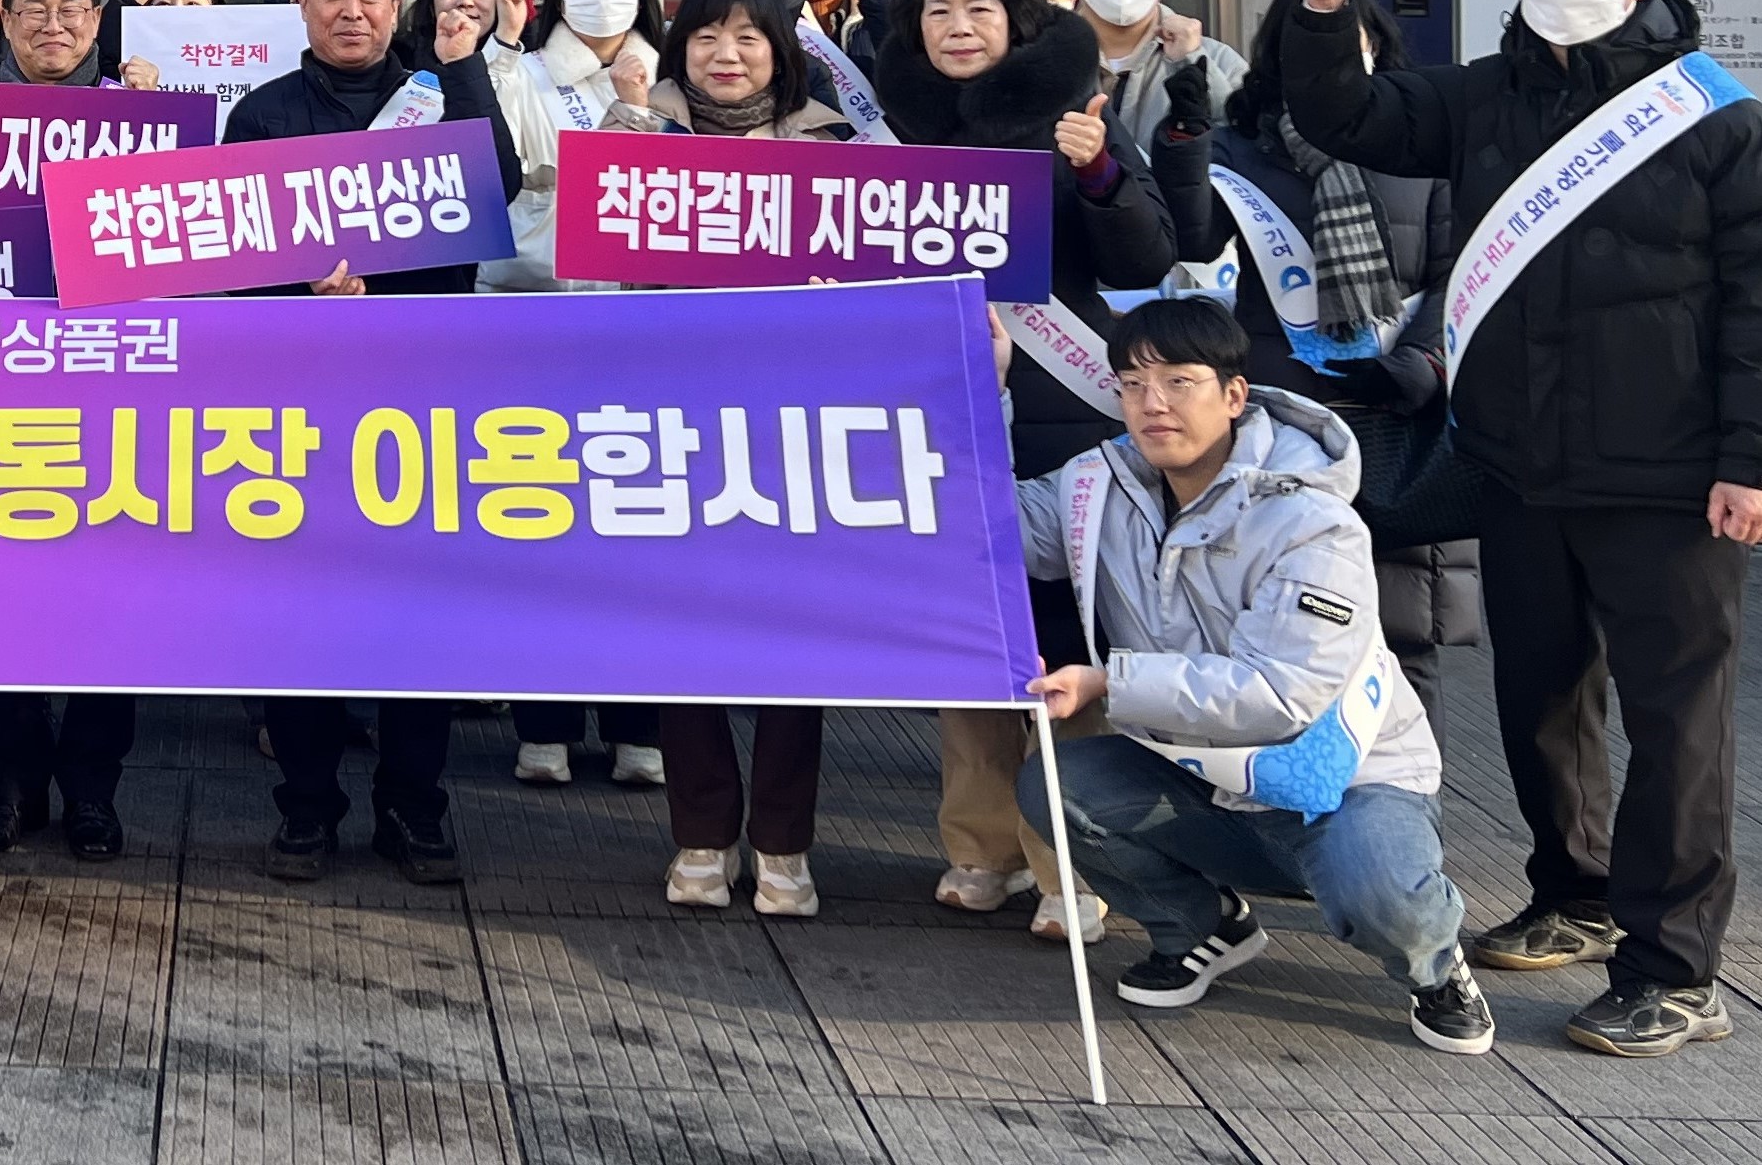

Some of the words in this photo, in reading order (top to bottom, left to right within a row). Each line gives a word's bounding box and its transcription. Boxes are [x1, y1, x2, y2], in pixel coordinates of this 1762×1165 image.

[181, 43, 269, 67] 착한결제
[1623, 101, 1664, 138] 지역
[1557, 128, 1627, 192] 물가안정
[86, 170, 278, 268] 착한결제
[285, 152, 473, 246] 지역상생
[596, 164, 793, 258] 착한결제
[807, 176, 1010, 269] 지역상생
[1507, 185, 1561, 238] 참여는
[351, 403, 945, 540] 이용합시다
